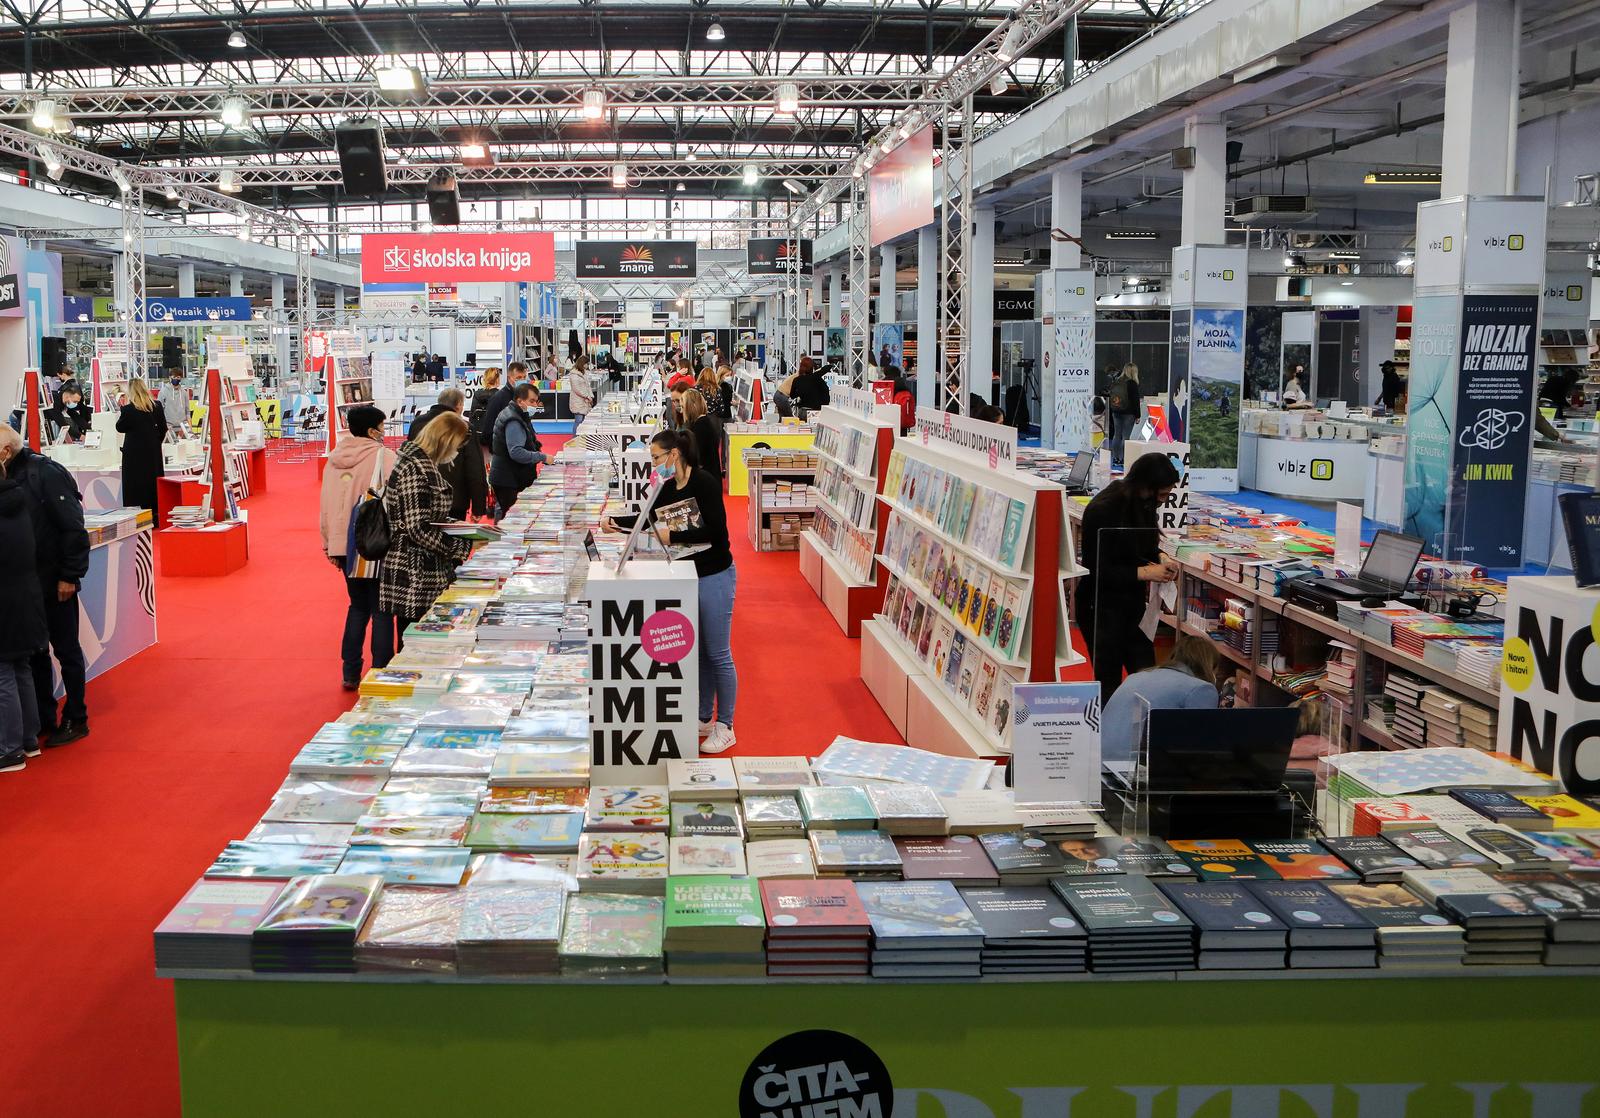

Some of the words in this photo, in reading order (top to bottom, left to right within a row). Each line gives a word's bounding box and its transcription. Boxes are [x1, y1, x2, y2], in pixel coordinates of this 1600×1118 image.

[413, 249, 476, 268] školska
[480, 248, 531, 272] knjiga
[620, 262, 654, 274] znanje
[170, 306, 202, 316] Mozaik
[1204, 330, 1230, 338] MOJA
[1464, 324, 1531, 353] MOZAK
[1197, 340, 1236, 348] PLANINA
[1418, 340, 1455, 356] TOLLE
[1462, 355, 1481, 371] BEZ
[1482, 355, 1528, 371] GRANICA
[1462, 464, 1481, 480] JIM
[1485, 464, 1513, 480] KWIK
[664, 506, 692, 520] Eureka
[682, 514, 688, 522] 3
[650, 622, 682, 636] Pripreme
[661, 632, 680, 643] školu
[1508, 652, 1525, 663] Novo
[1509, 665, 1528, 676] hitovi
[593, 730, 682, 766] IKA
[754, 1060, 870, 1108] ČITA-
